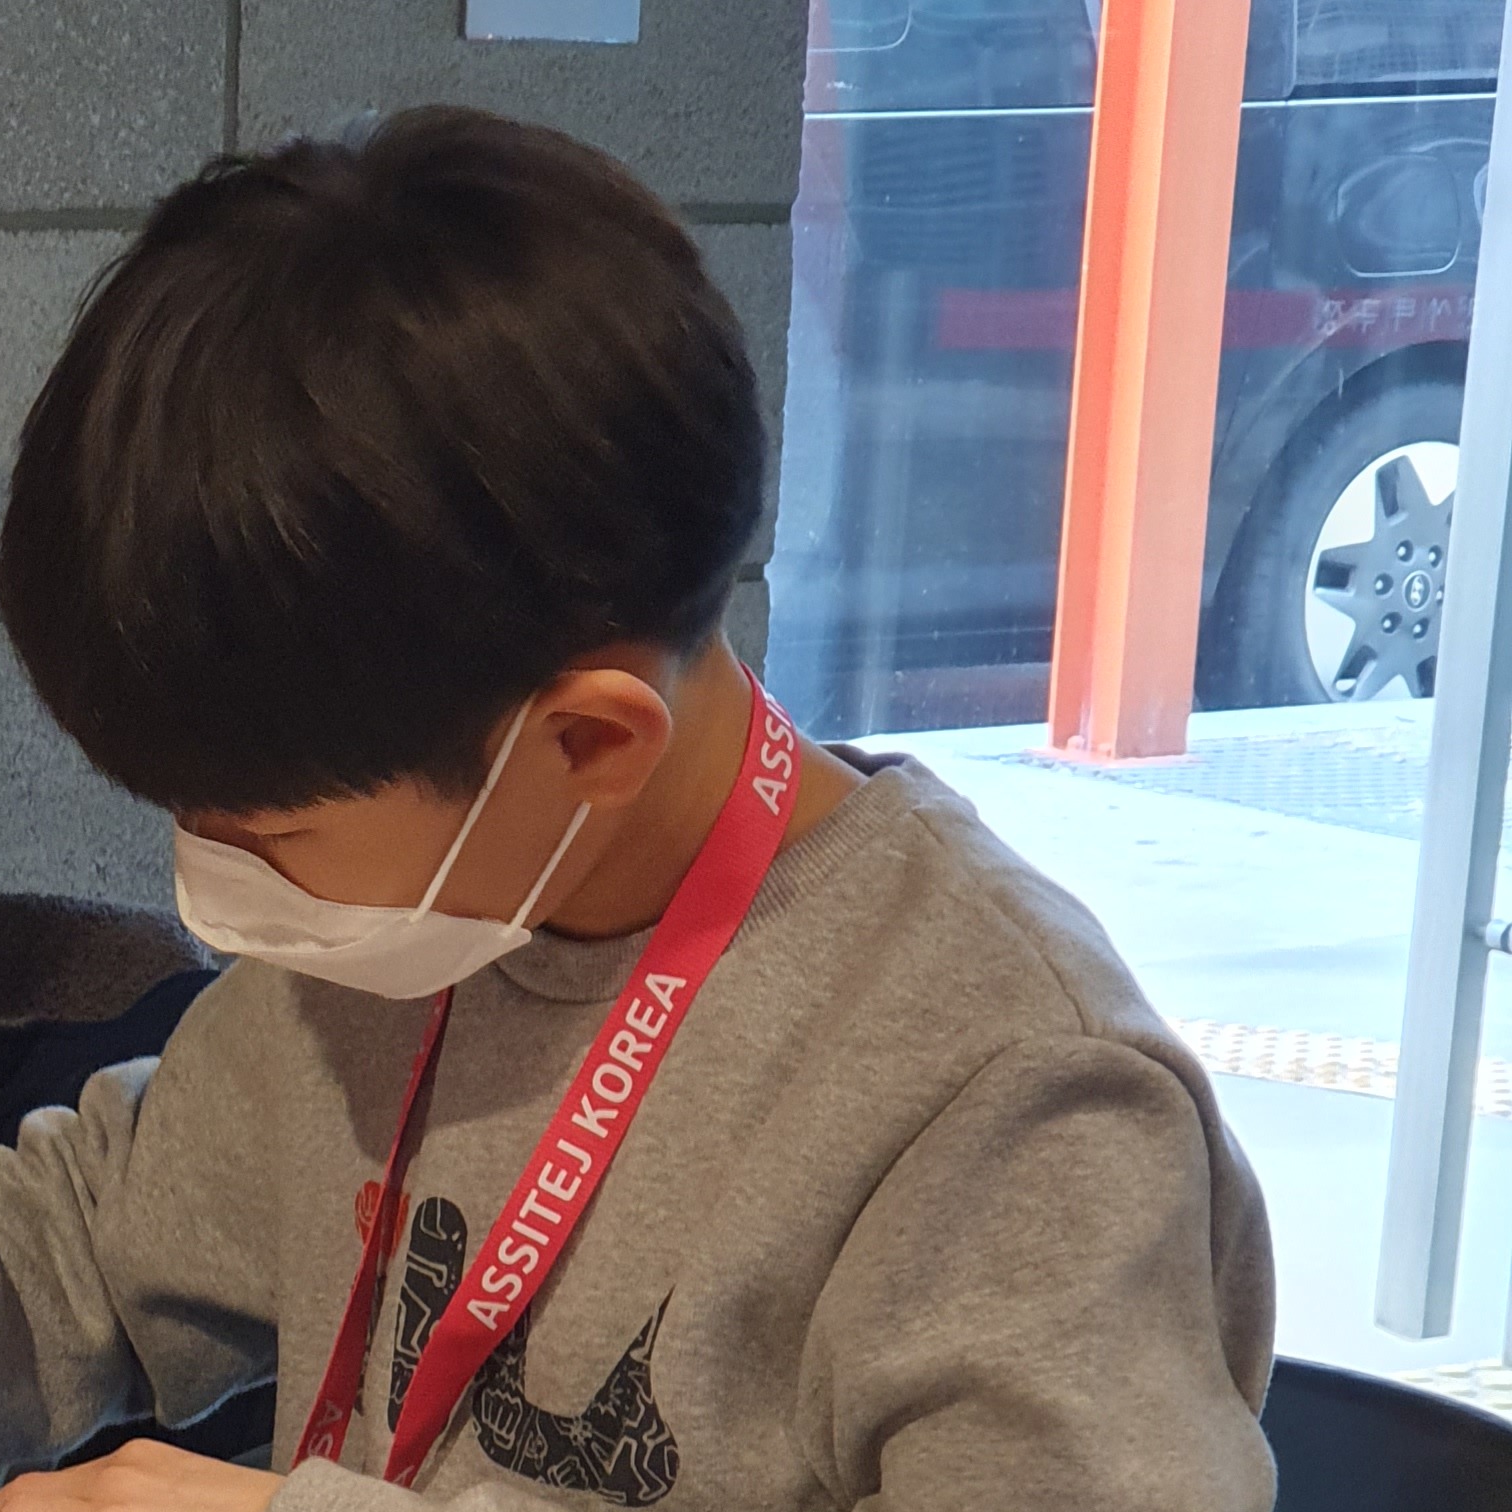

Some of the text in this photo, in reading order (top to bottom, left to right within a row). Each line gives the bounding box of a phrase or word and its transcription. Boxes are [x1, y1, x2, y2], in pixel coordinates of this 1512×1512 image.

[752, 697, 795, 816] ASSI
[467, 972, 687, 1331] ASSITEJ KOREA
